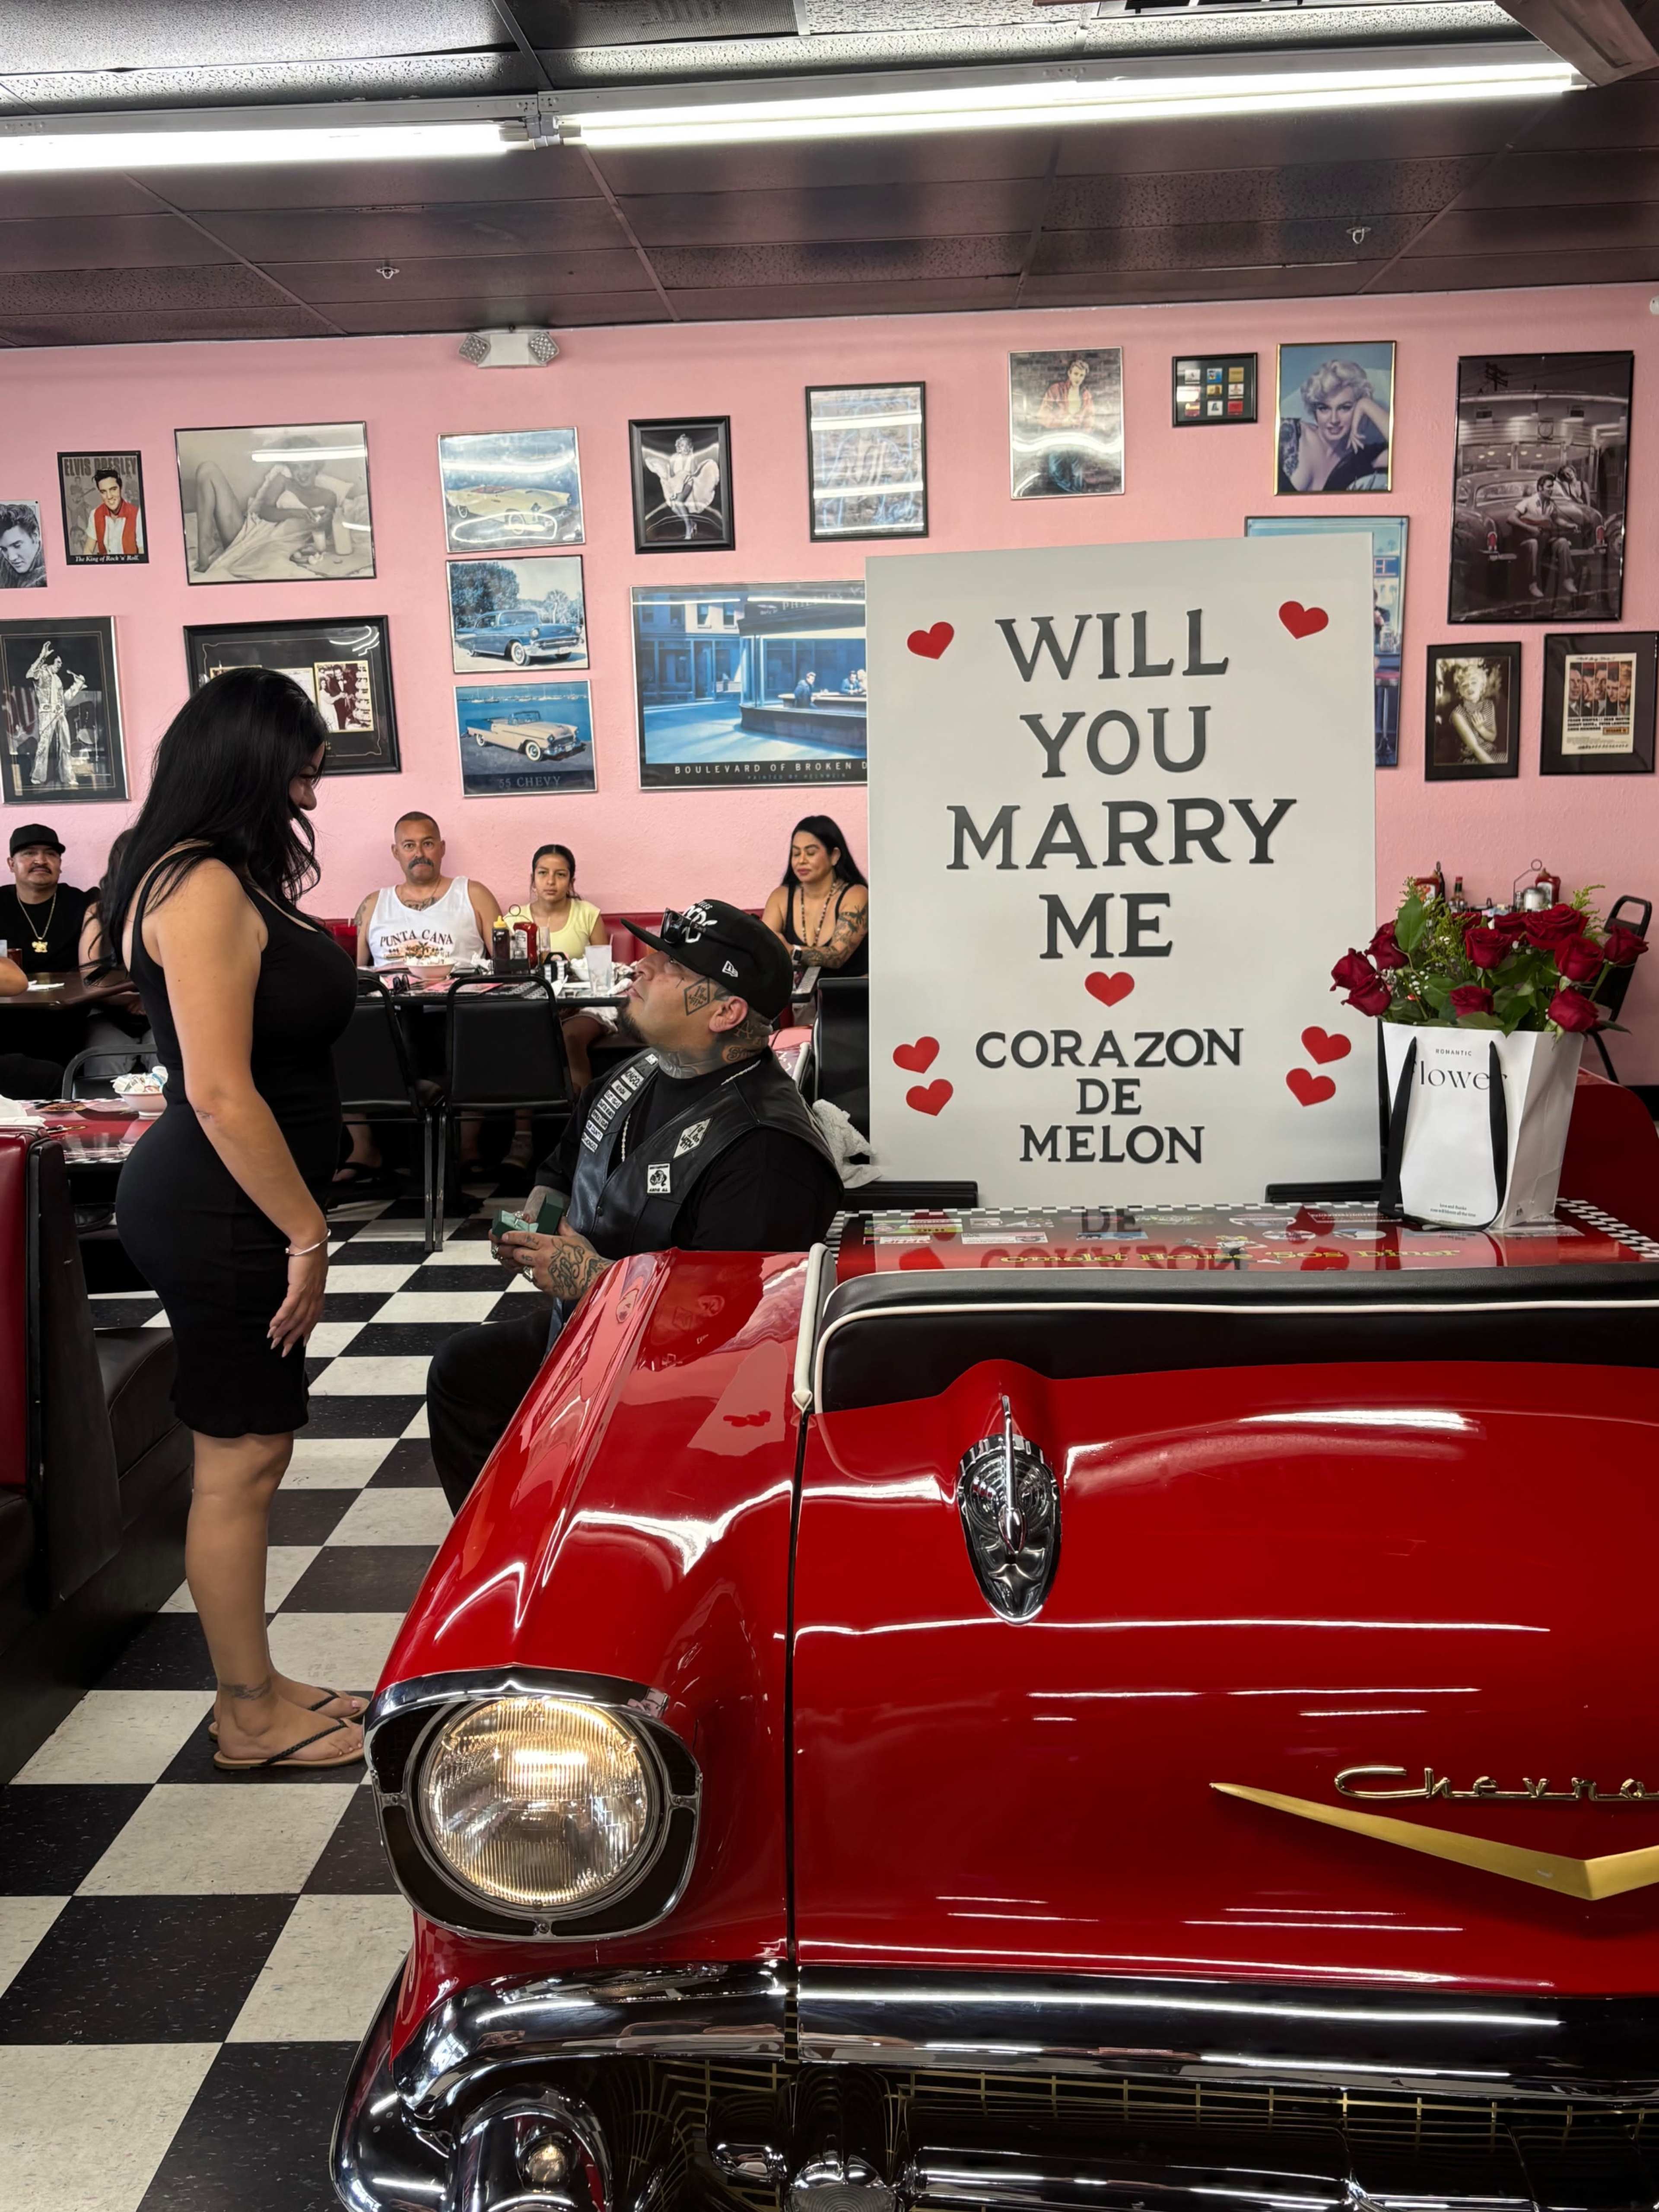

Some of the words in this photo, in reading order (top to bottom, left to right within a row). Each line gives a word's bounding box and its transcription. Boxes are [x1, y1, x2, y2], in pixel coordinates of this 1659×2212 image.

[64, 458, 92, 476] ELVIS
[995, 609, 1229, 681] WILL
[1020, 706, 1211, 778] YOU
[516, 776, 560, 788] CHEVY
[674, 764, 760, 774] BOULEVARD
[770, 763, 785, 772] OF
[795, 762, 852, 771] BROKEN
[947, 798, 1297, 869] MARRY
[380, 930, 417, 947] PUNTA
[421, 929, 454, 945] CANA
[1039, 893, 1173, 959] ME
[976, 1028, 1243, 1068] CORAZON
[1435, 1048, 1472, 1057] ROMANTIC
[1414, 1060, 1508, 1090] lowe
[1076, 1079, 1141, 1115] DE
[1020, 1125, 1205, 1164] MELON
[1001, 1253, 1128, 1263] Omelet
[1352, 1249, 1460, 1257] Diner
